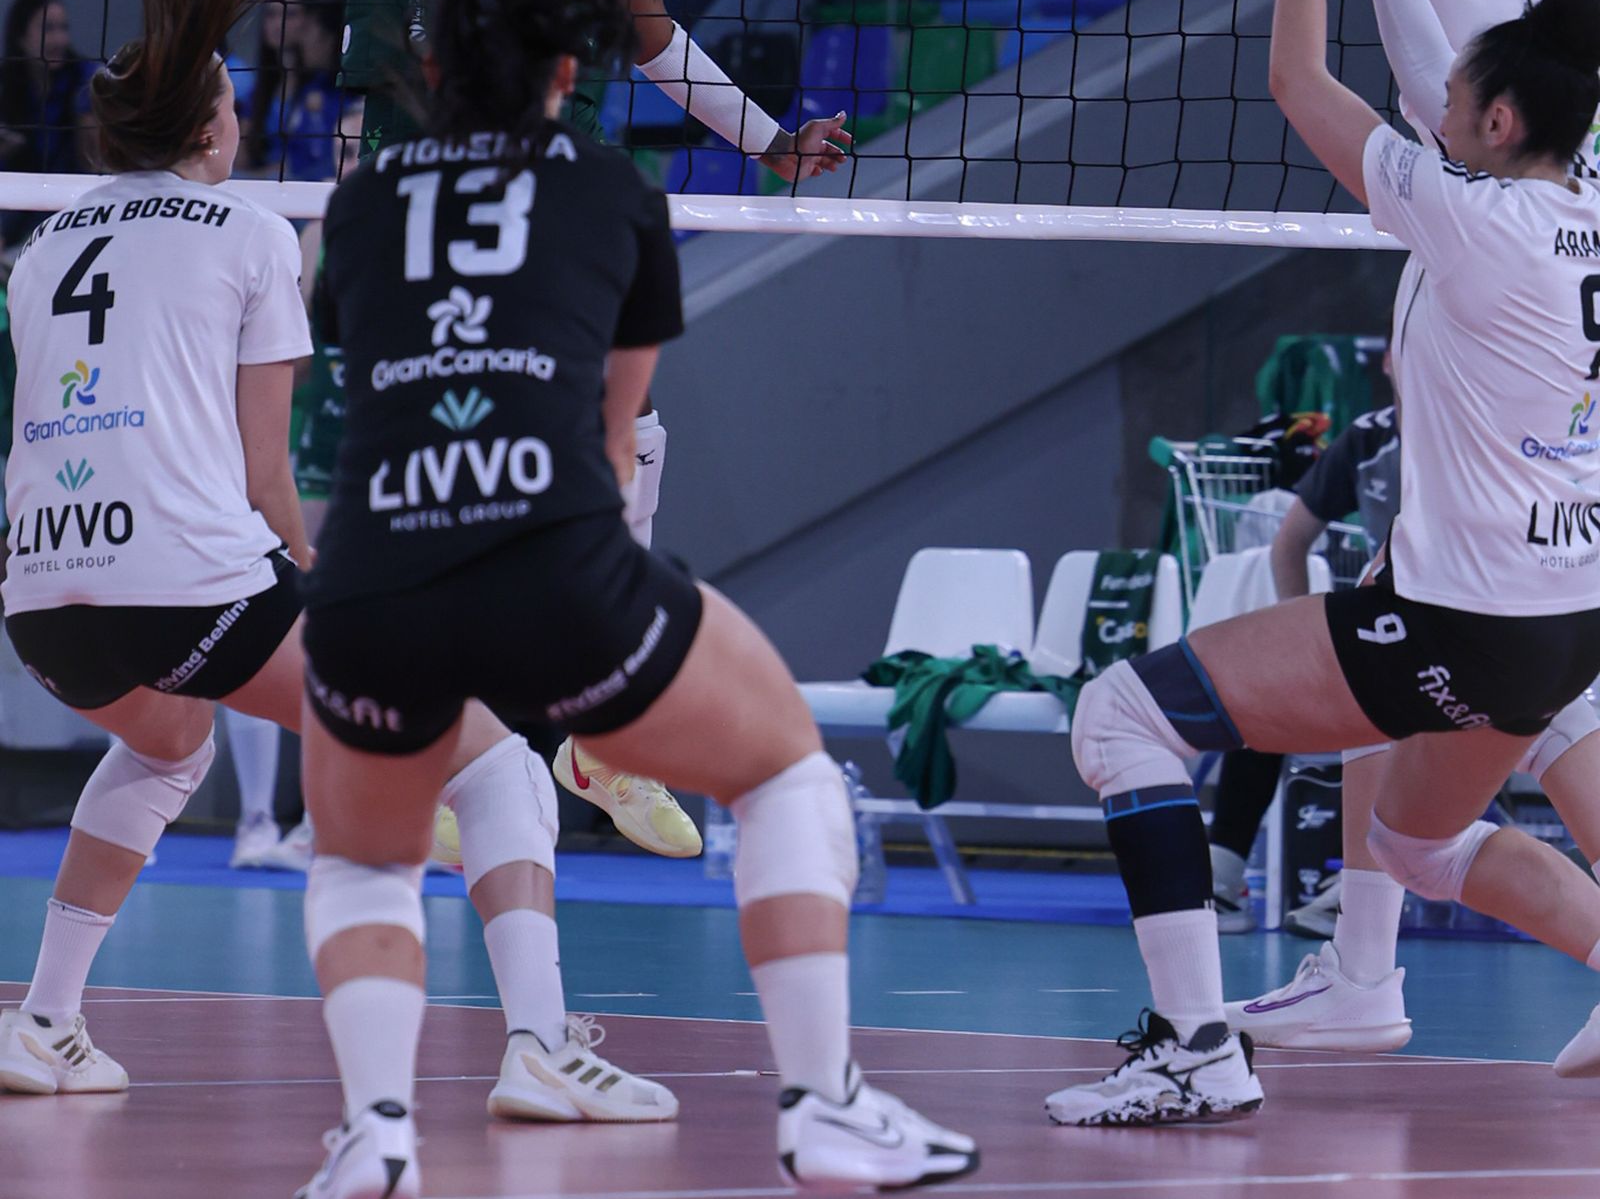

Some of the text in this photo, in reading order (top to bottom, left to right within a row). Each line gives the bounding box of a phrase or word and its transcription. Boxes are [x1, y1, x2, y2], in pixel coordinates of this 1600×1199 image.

[52, 204, 116, 232] DEN
[119, 197, 232, 227] BOSCH
[396, 166, 536, 282] 13
[51, 235, 115, 345] 4
[370, 346, 557, 392] GranCanaria
[23, 405, 146, 444] GranCanaria
[369, 436, 553, 512] LIVVO
[16, 500, 134, 557] LIVVO
[390, 499, 531, 531] HOTEL GROUP
[23, 555, 116, 576] HOTEL GROUP
[1356, 612, 1408, 645] 9
